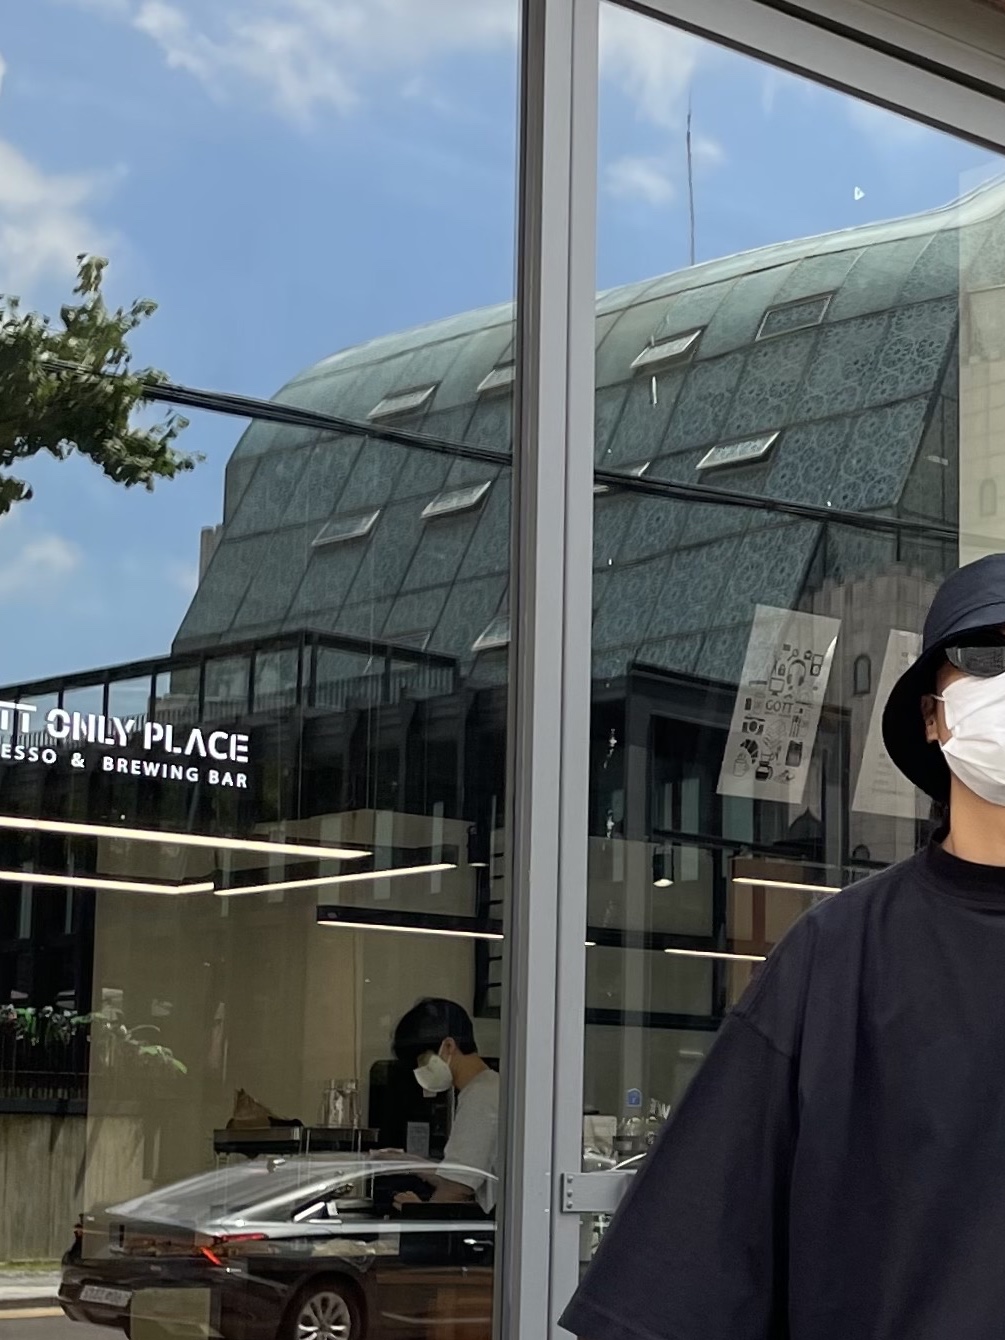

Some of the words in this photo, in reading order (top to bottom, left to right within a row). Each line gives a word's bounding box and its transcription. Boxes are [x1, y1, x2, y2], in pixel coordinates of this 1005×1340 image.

[47, 708, 136, 747] ONLY
[143, 721, 250, 764] PLACE
[70, 752, 85, 769] &
[103, 756, 200, 783] BREWING
[208, 769, 249, 789] BAR
